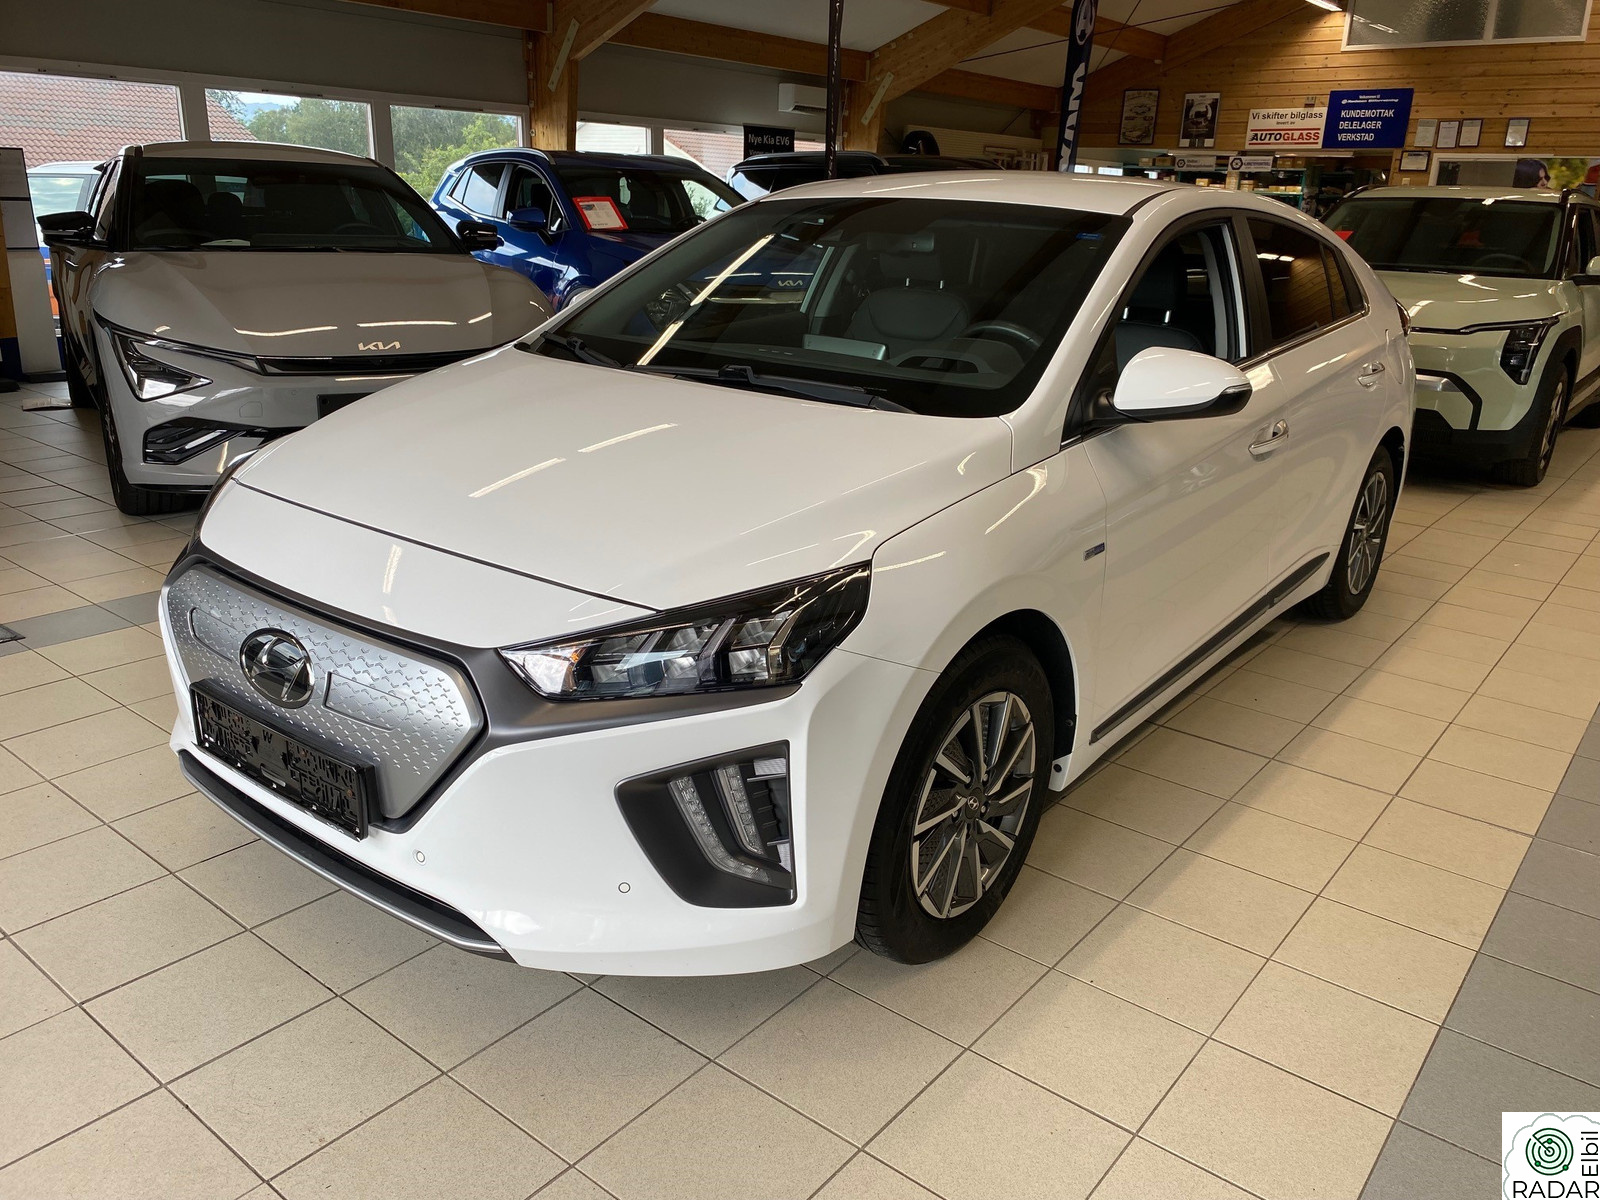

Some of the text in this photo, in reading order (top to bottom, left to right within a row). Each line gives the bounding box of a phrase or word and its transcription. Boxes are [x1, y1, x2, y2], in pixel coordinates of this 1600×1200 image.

[1251, 111, 1323, 121] Vi skifter bilglass
[1340, 109, 1395, 118] KUNDEMOTTAK
[1338, 121, 1382, 130] DELELAGER
[748, 133, 790, 146] Nye Kia EV6
[1248, 131, 1320, 142] AUTOGLASS
[1337, 133, 1375, 142] VERKSTAD
